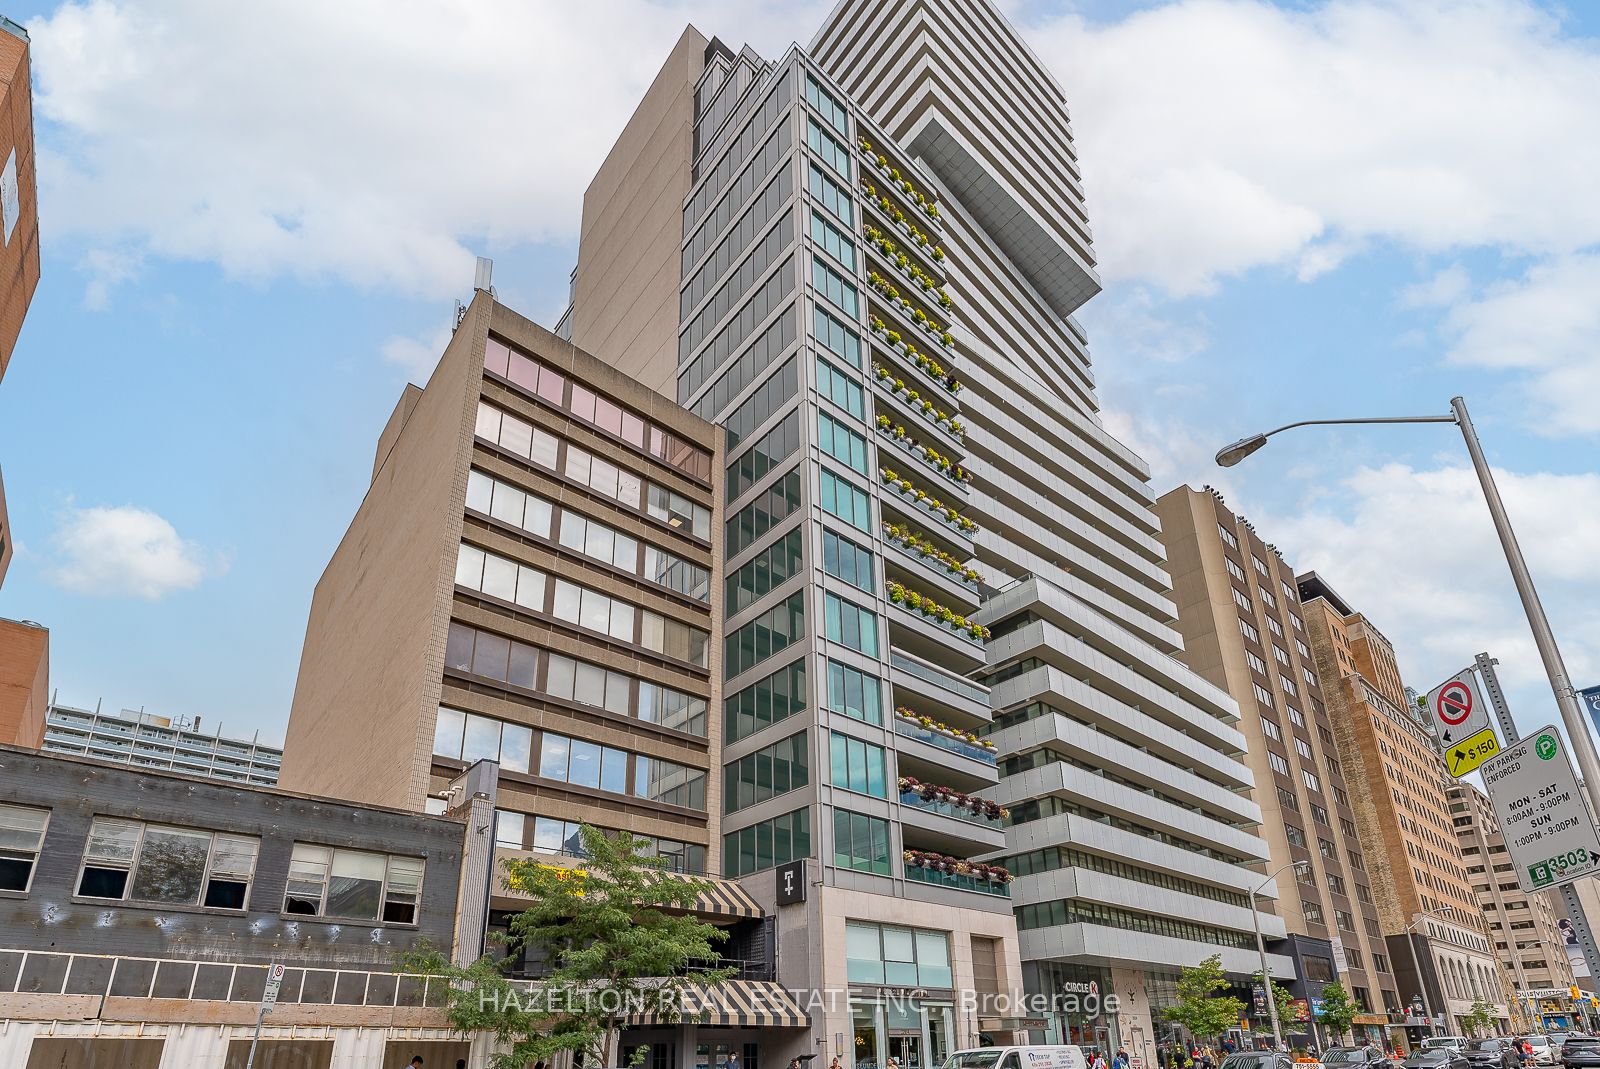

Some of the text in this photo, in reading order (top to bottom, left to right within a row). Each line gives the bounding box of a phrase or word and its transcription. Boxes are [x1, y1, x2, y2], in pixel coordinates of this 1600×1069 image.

[1483, 746, 1527, 775] PAY PARKG
[1486, 762, 1521, 785] ENFORCED
[1506, 807, 1535, 826] 8:00AM
[1540, 792, 1571, 811] 9:00PM
[1509, 796, 1531, 811] MON
[1538, 783, 1557, 798] SAT
[1515, 831, 1543, 848] 1:00PM
[1548, 816, 1580, 835] 9:00PM
[1530, 814, 1552, 828] SUN
[1548, 848, 1588, 873] 3503
[1065, 982, 1089, 993] CIRCLE
